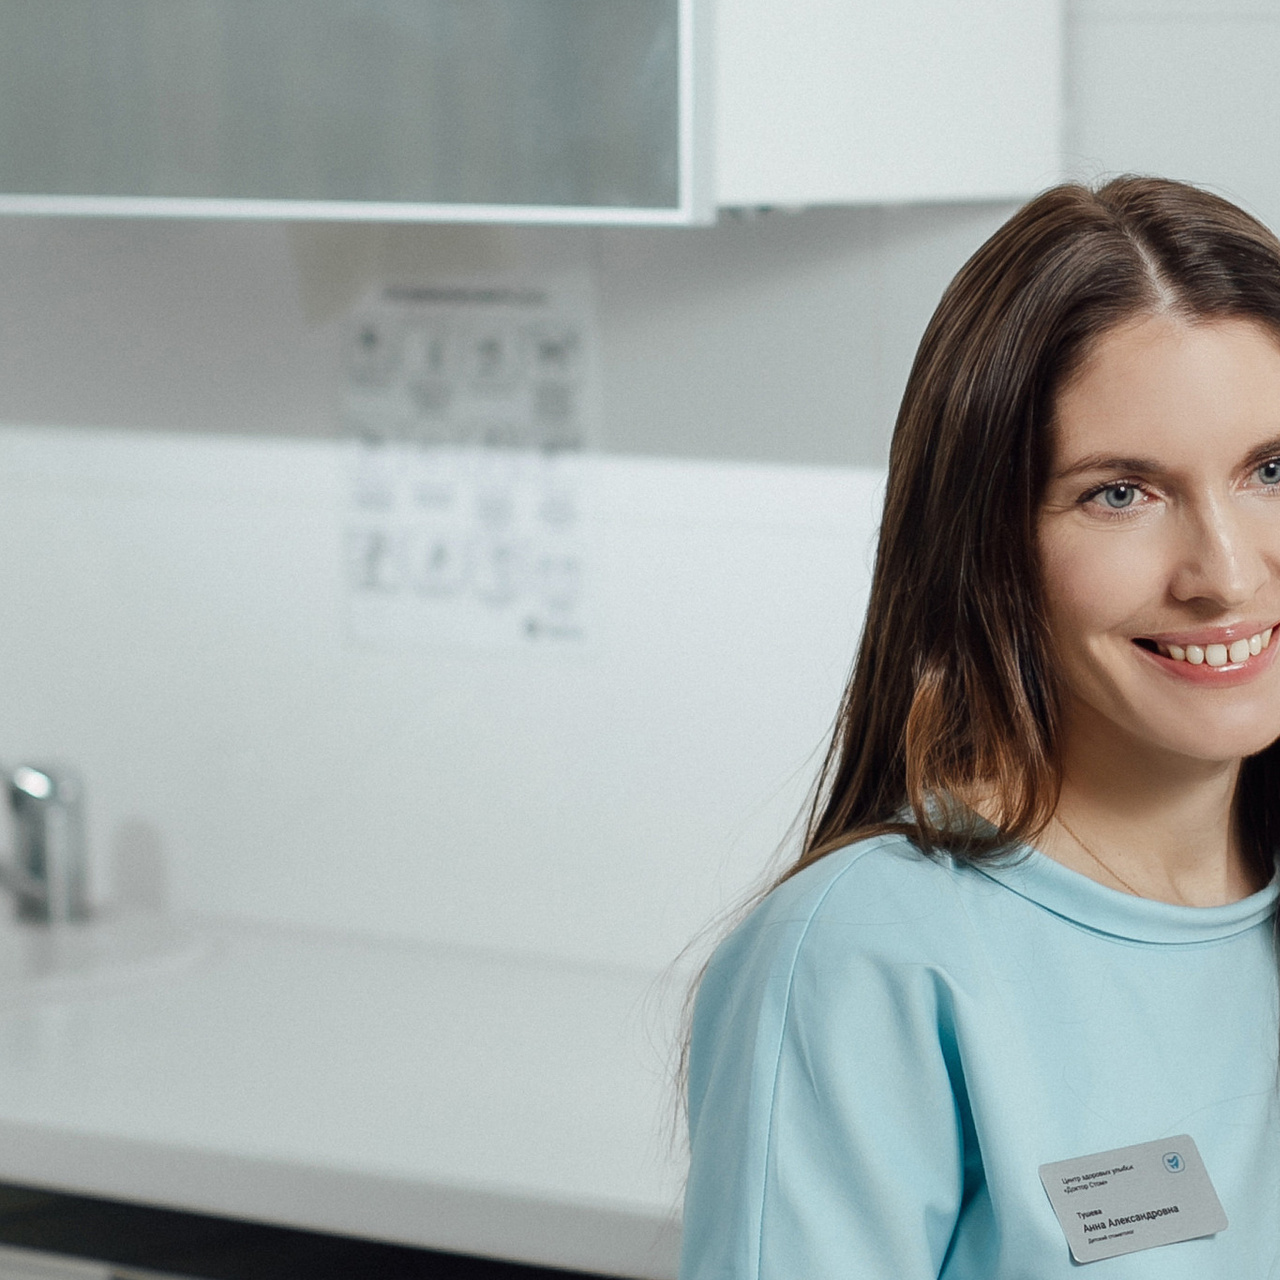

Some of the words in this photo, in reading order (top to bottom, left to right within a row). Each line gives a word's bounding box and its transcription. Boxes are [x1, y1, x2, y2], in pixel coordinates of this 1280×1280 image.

[1061, 1176, 1081, 1185] Центр
[1077, 1209, 1102, 1220] Тушева
[1084, 1222, 1107, 1233] Анна
[1108, 1205, 1179, 1228] Александровна
